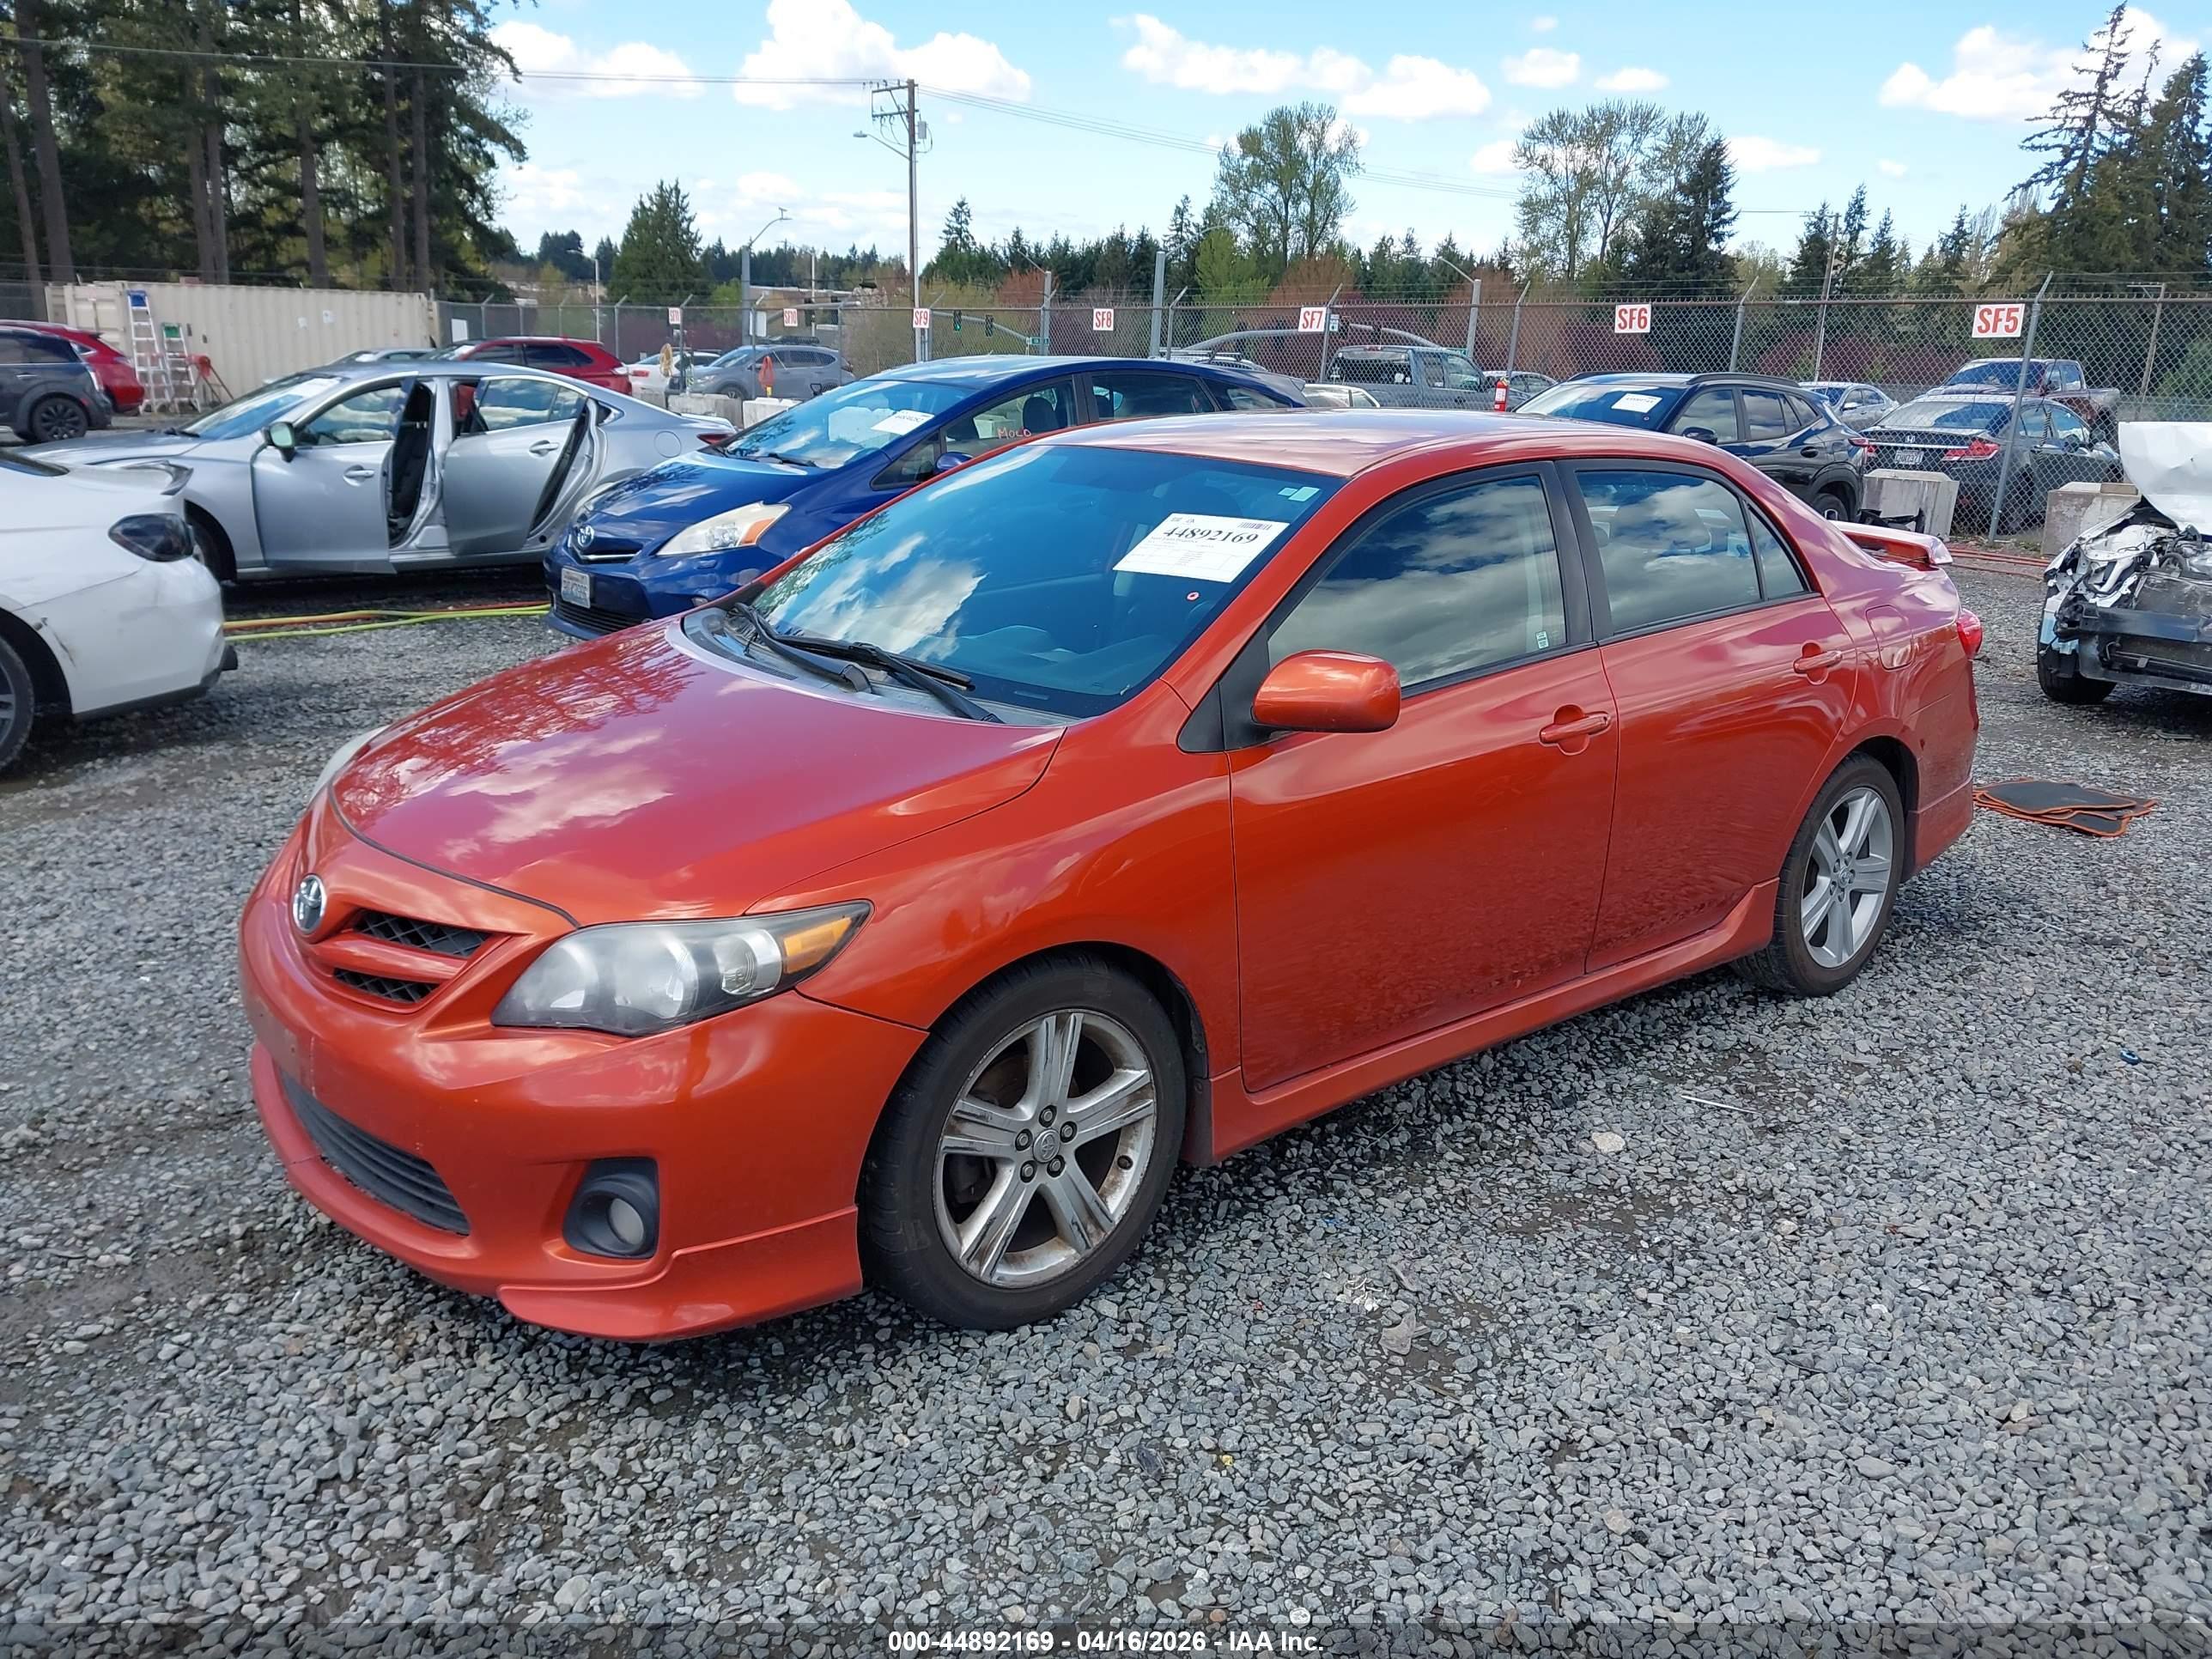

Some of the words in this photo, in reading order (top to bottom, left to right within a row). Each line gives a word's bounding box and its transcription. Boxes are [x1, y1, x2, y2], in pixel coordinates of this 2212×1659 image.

[785, 310, 797, 324] SF10
[915, 310, 928, 325] SF9
[1095, 311, 1112, 328] SF8
[1302, 310, 1323, 329] SF7
[1618, 307, 1648, 330] SF6
[1978, 307, 2020, 333] SF5
[1163, 526, 1259, 544] 44892169
